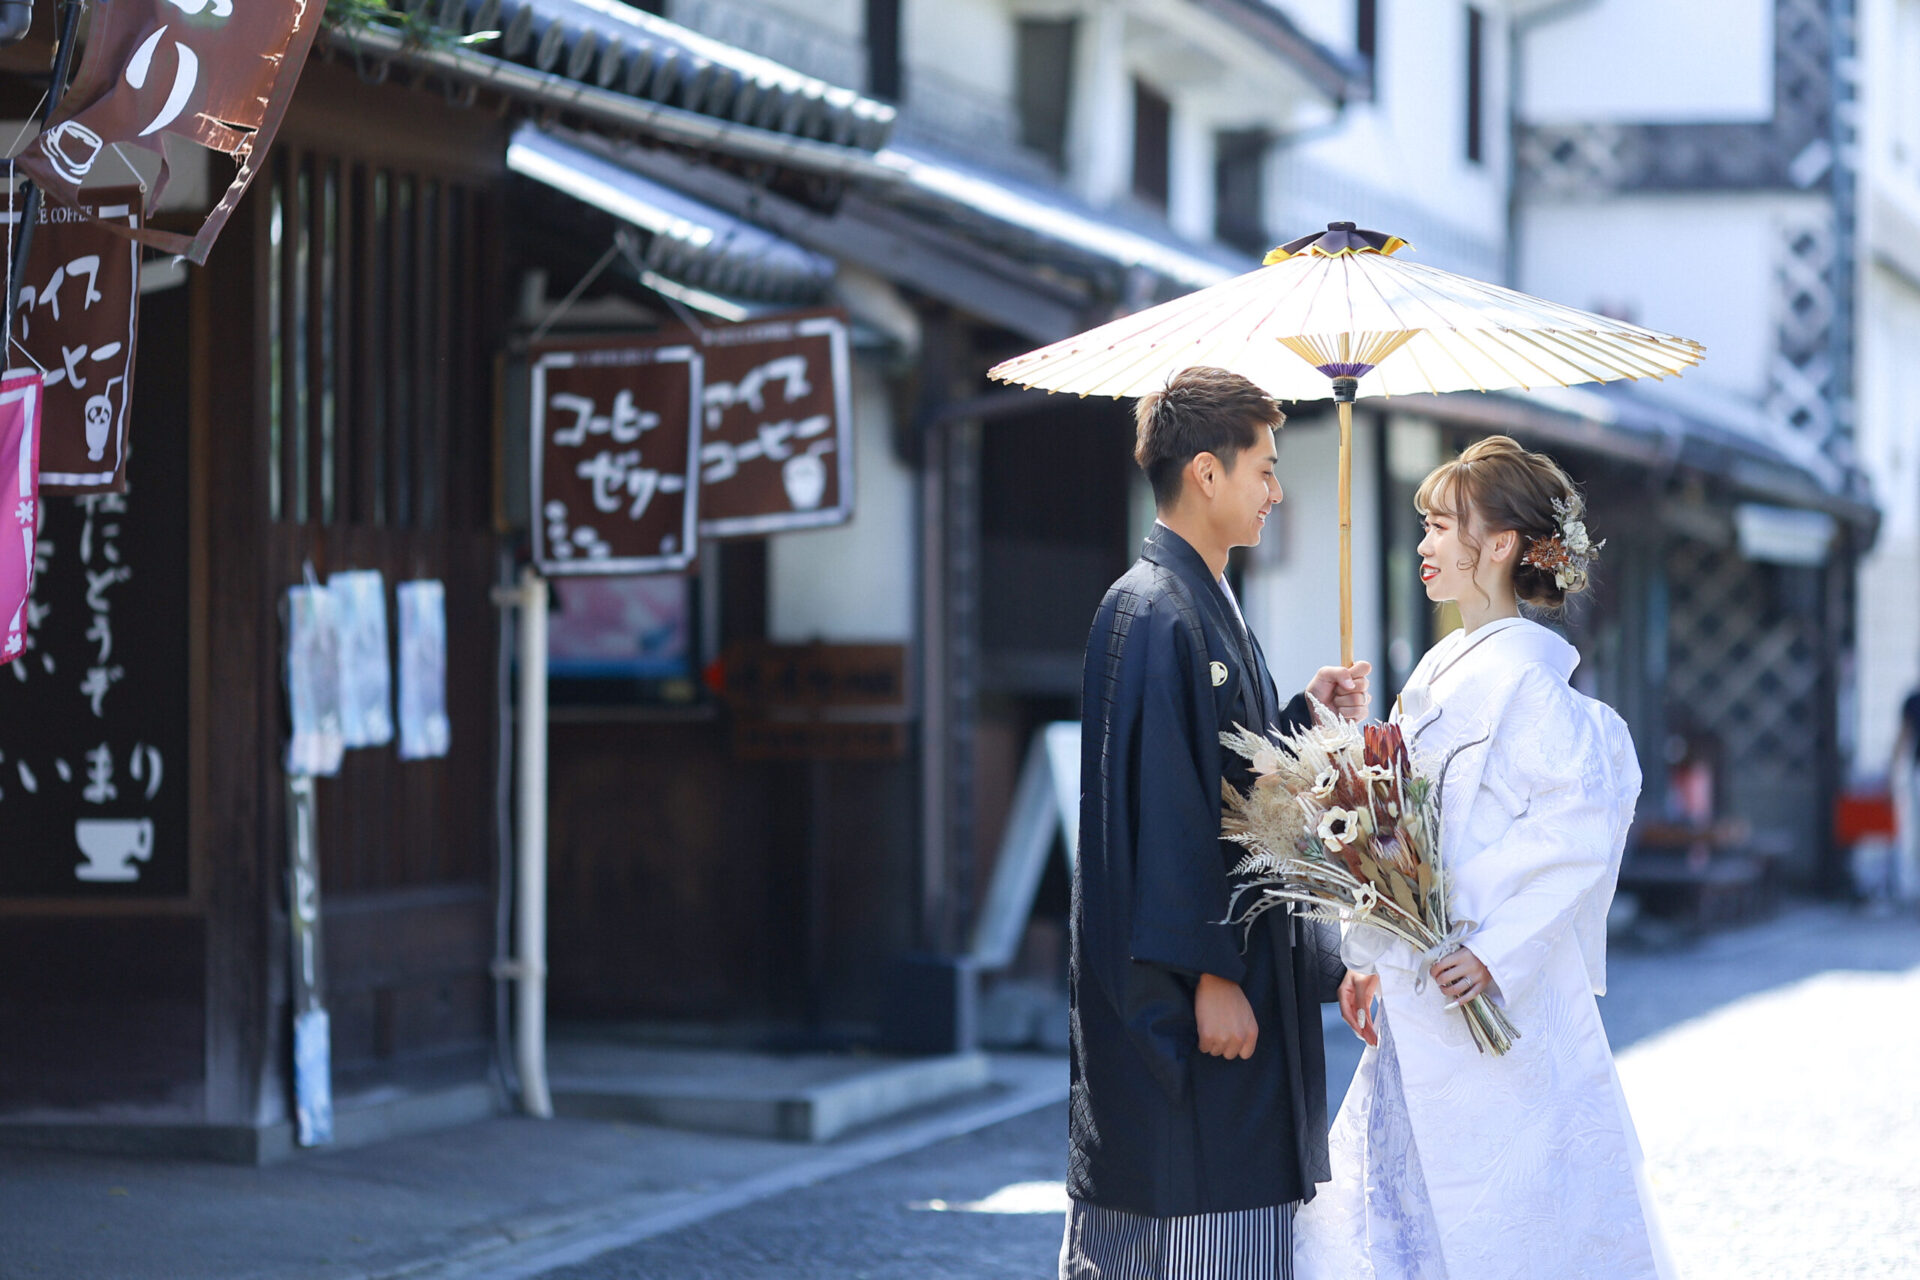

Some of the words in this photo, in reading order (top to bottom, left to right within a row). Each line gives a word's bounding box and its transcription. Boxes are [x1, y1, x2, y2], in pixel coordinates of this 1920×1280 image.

[125, 0, 233, 137] り
[17, 254, 102, 342] アイス
[551, 388, 662, 445] コーヒー
[703, 355, 811, 430] アイス
[702, 413, 830, 483] コーヒー
[576, 450, 686, 520] ゼリー
[0, 741, 163, 804] いまり
